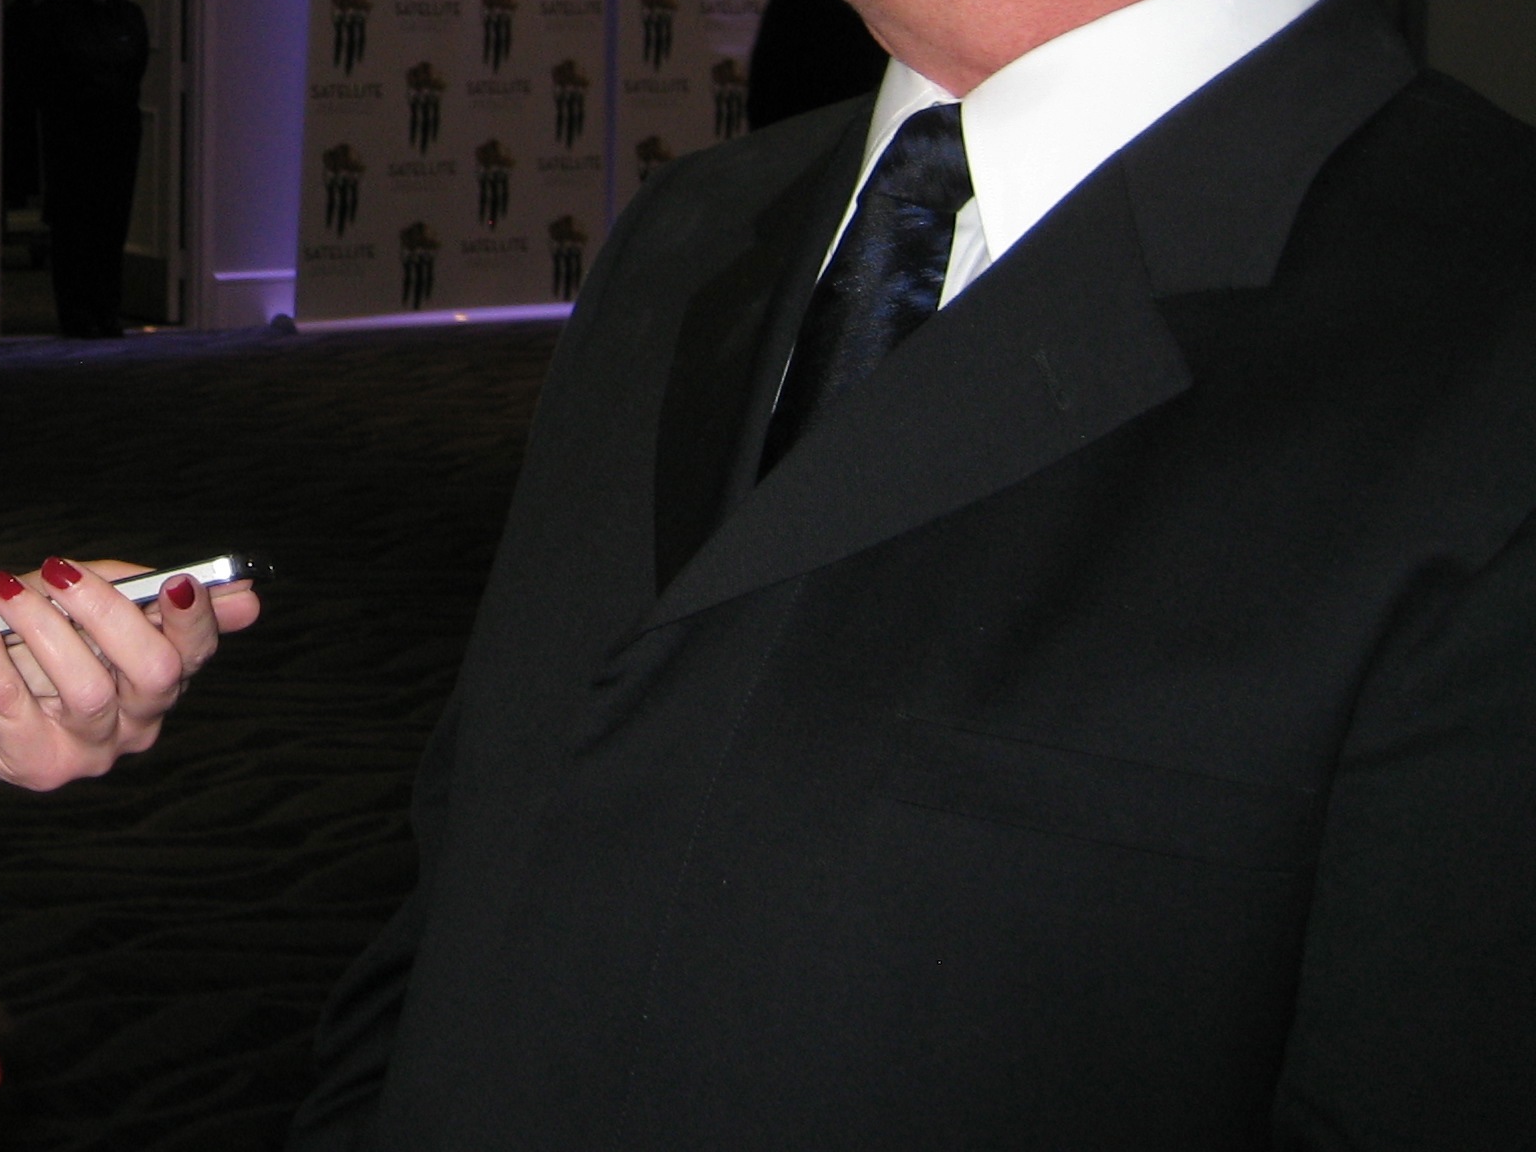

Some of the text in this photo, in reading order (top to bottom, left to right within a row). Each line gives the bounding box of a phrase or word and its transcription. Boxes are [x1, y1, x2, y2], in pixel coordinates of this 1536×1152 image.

[395, 1, 461, 16] SATELLITE
[540, 0, 602, 16] SATELLITE
[310, 83, 383, 99] SATELLITE
[467, 79, 531, 95] SATELLITE
[388, 161, 457, 178] SATELLITE
[537, 155, 602, 172] SATELLITE
[303, 244, 375, 261] SATELLITE
[461, 237, 528, 254] SATELLITE
